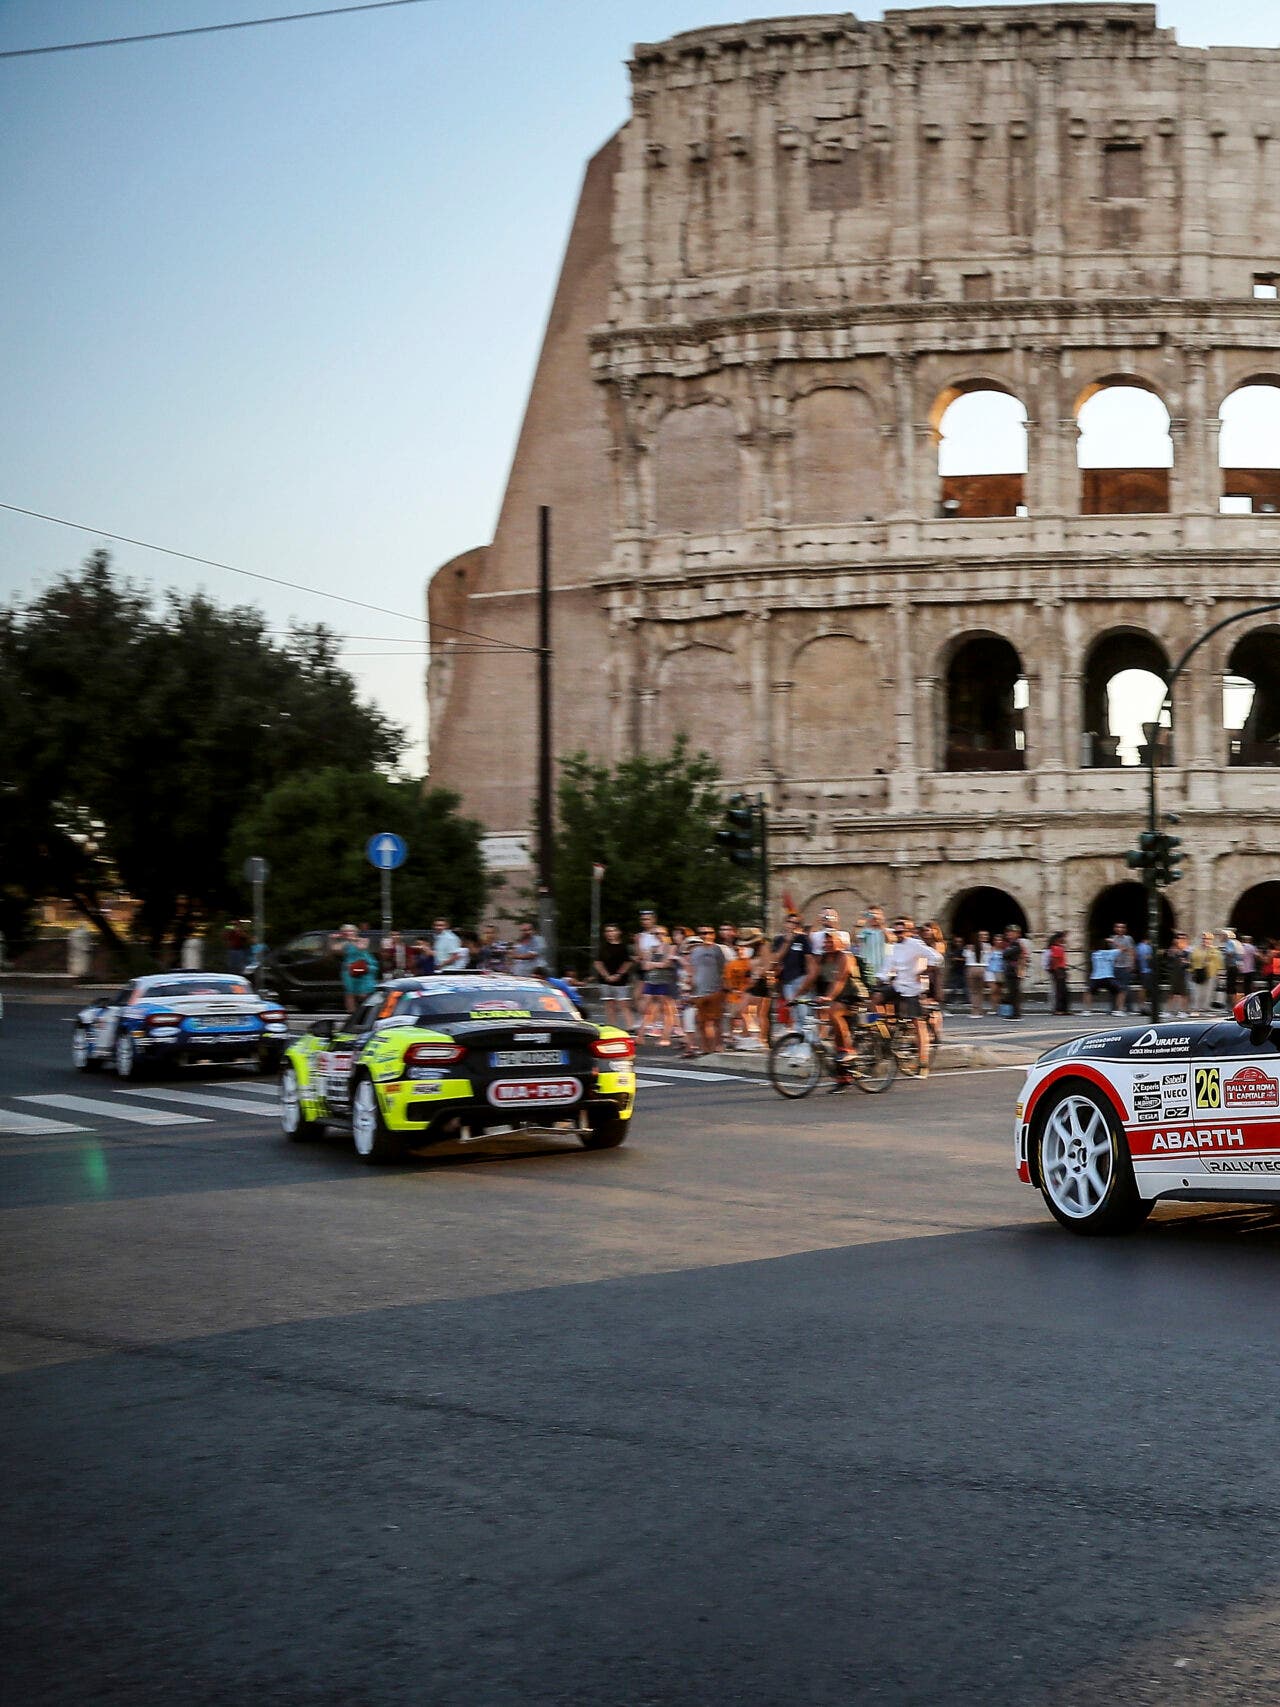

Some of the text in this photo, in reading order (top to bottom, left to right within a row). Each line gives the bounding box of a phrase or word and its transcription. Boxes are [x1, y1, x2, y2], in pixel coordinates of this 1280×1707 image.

[1196, 1068, 1220, 1108] 26
[1226, 1084, 1247, 1092] RALLY
[1256, 1083, 1276, 1091] ROMA
[1163, 1088, 1188, 1099] IVECO
[1236, 1092, 1266, 1100] CAPITALE
[1165, 1108, 1188, 1117] OZ
[1151, 1128, 1245, 1150] ABARTH
